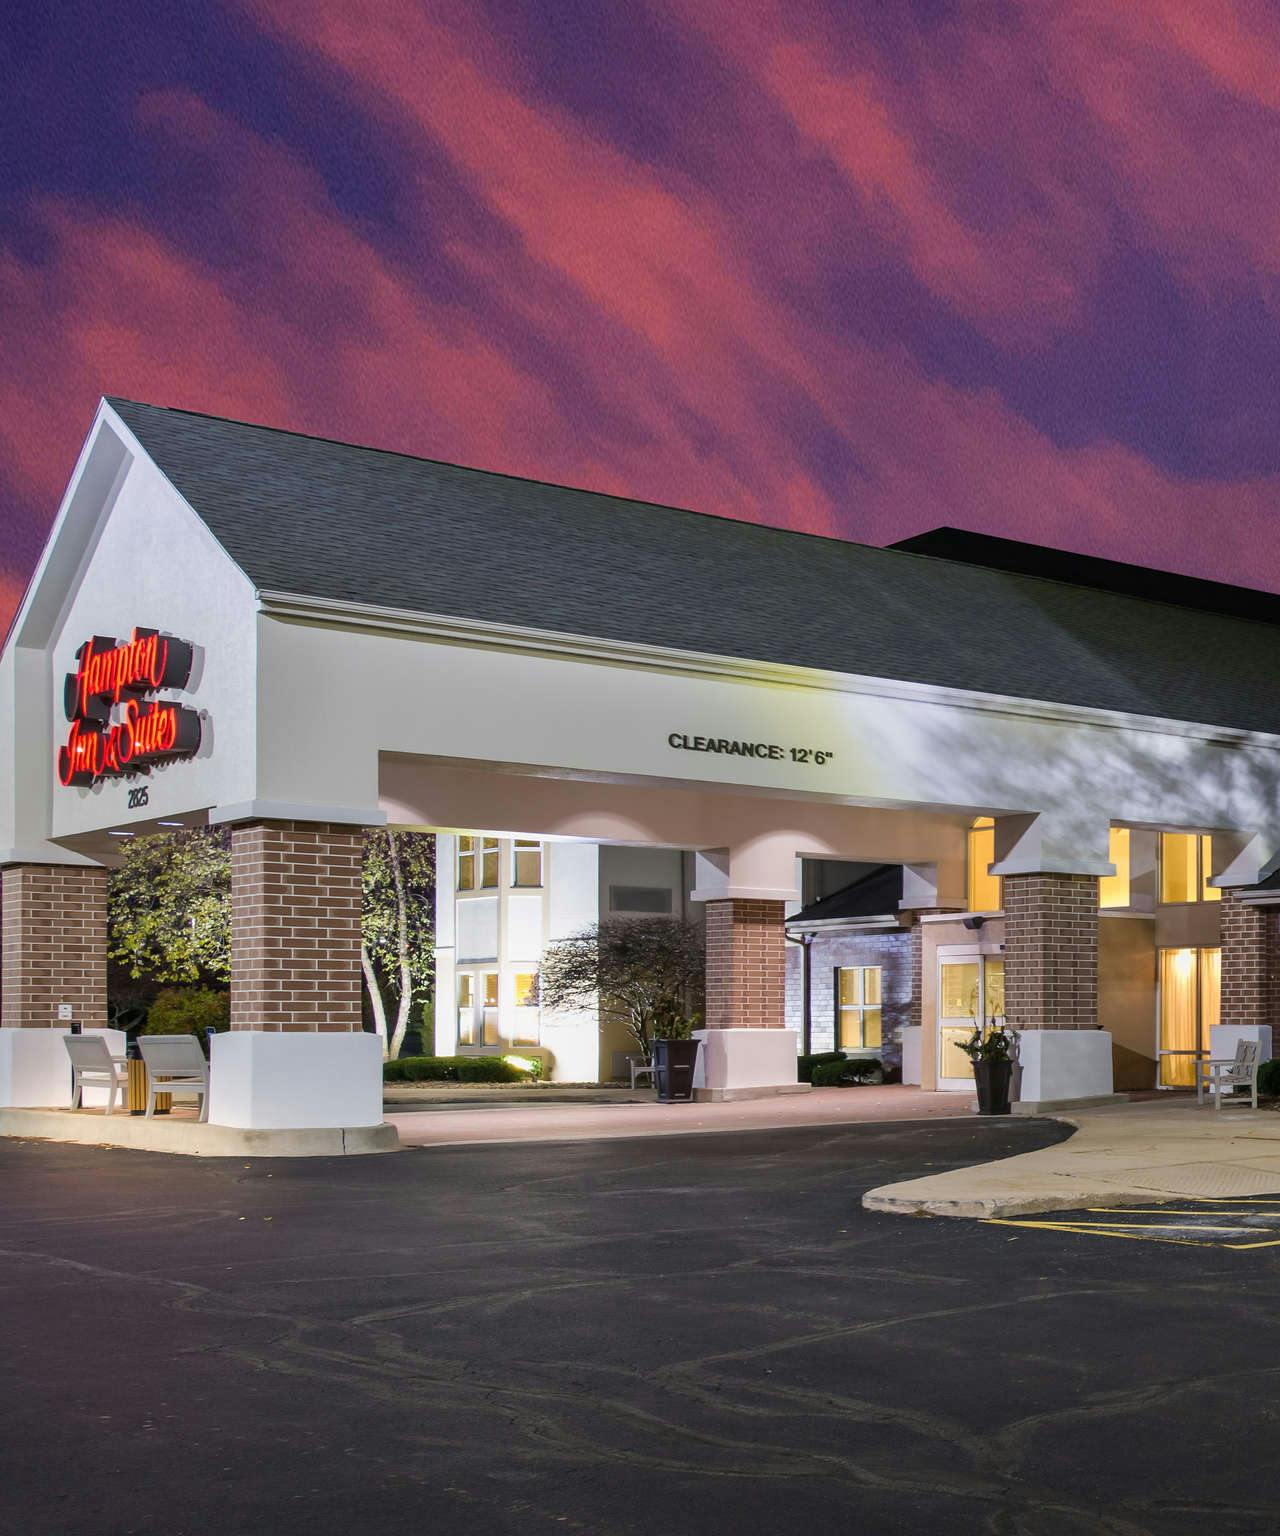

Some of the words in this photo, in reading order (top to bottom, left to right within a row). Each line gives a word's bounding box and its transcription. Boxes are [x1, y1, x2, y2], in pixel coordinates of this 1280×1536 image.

[66, 627, 171, 718] Hampton
[58, 719, 105, 787] Inn
[118, 699, 176, 763] Suites
[668, 733, 785, 760] CLEARANCE:
[128, 786, 149, 809] 2825
